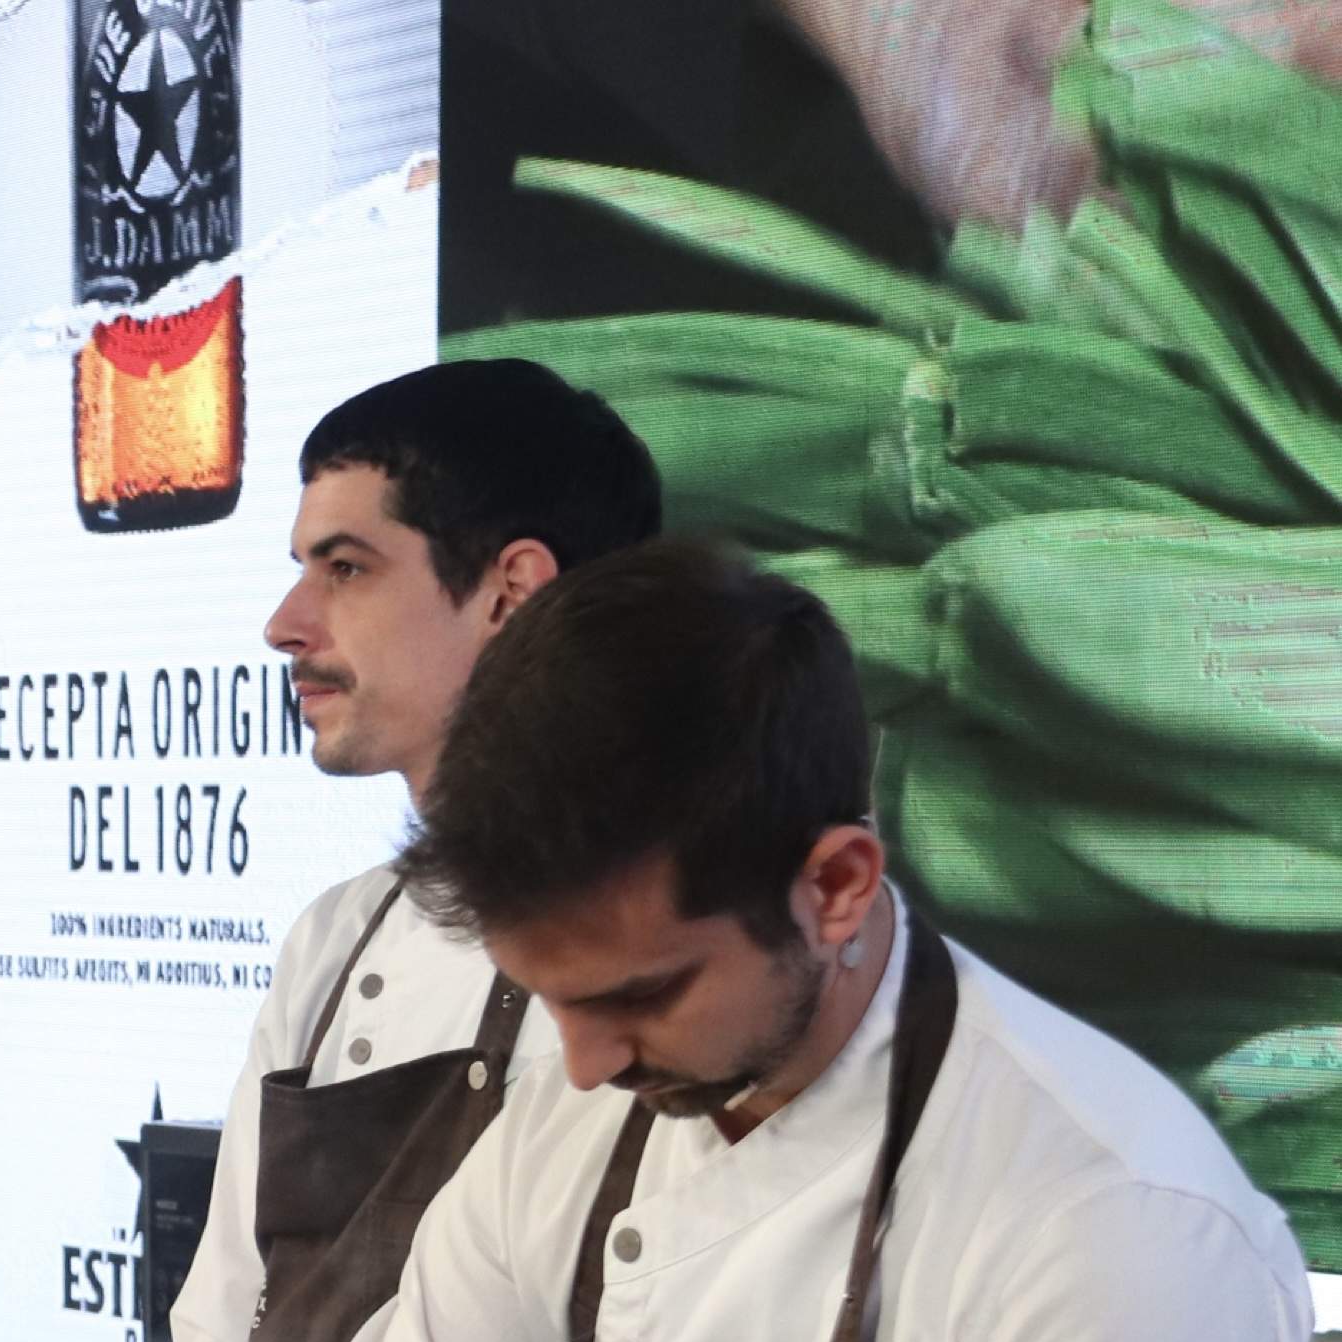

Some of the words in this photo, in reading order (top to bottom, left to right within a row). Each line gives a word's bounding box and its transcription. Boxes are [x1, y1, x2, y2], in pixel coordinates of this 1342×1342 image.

[69, 785, 140, 872] DEL
[155, 782, 250, 876] 1876
[50, 911, 88, 937] 100%
[92, 913, 183, 941] INGREDIENTS
[188, 917, 271, 945] NATURALS.
